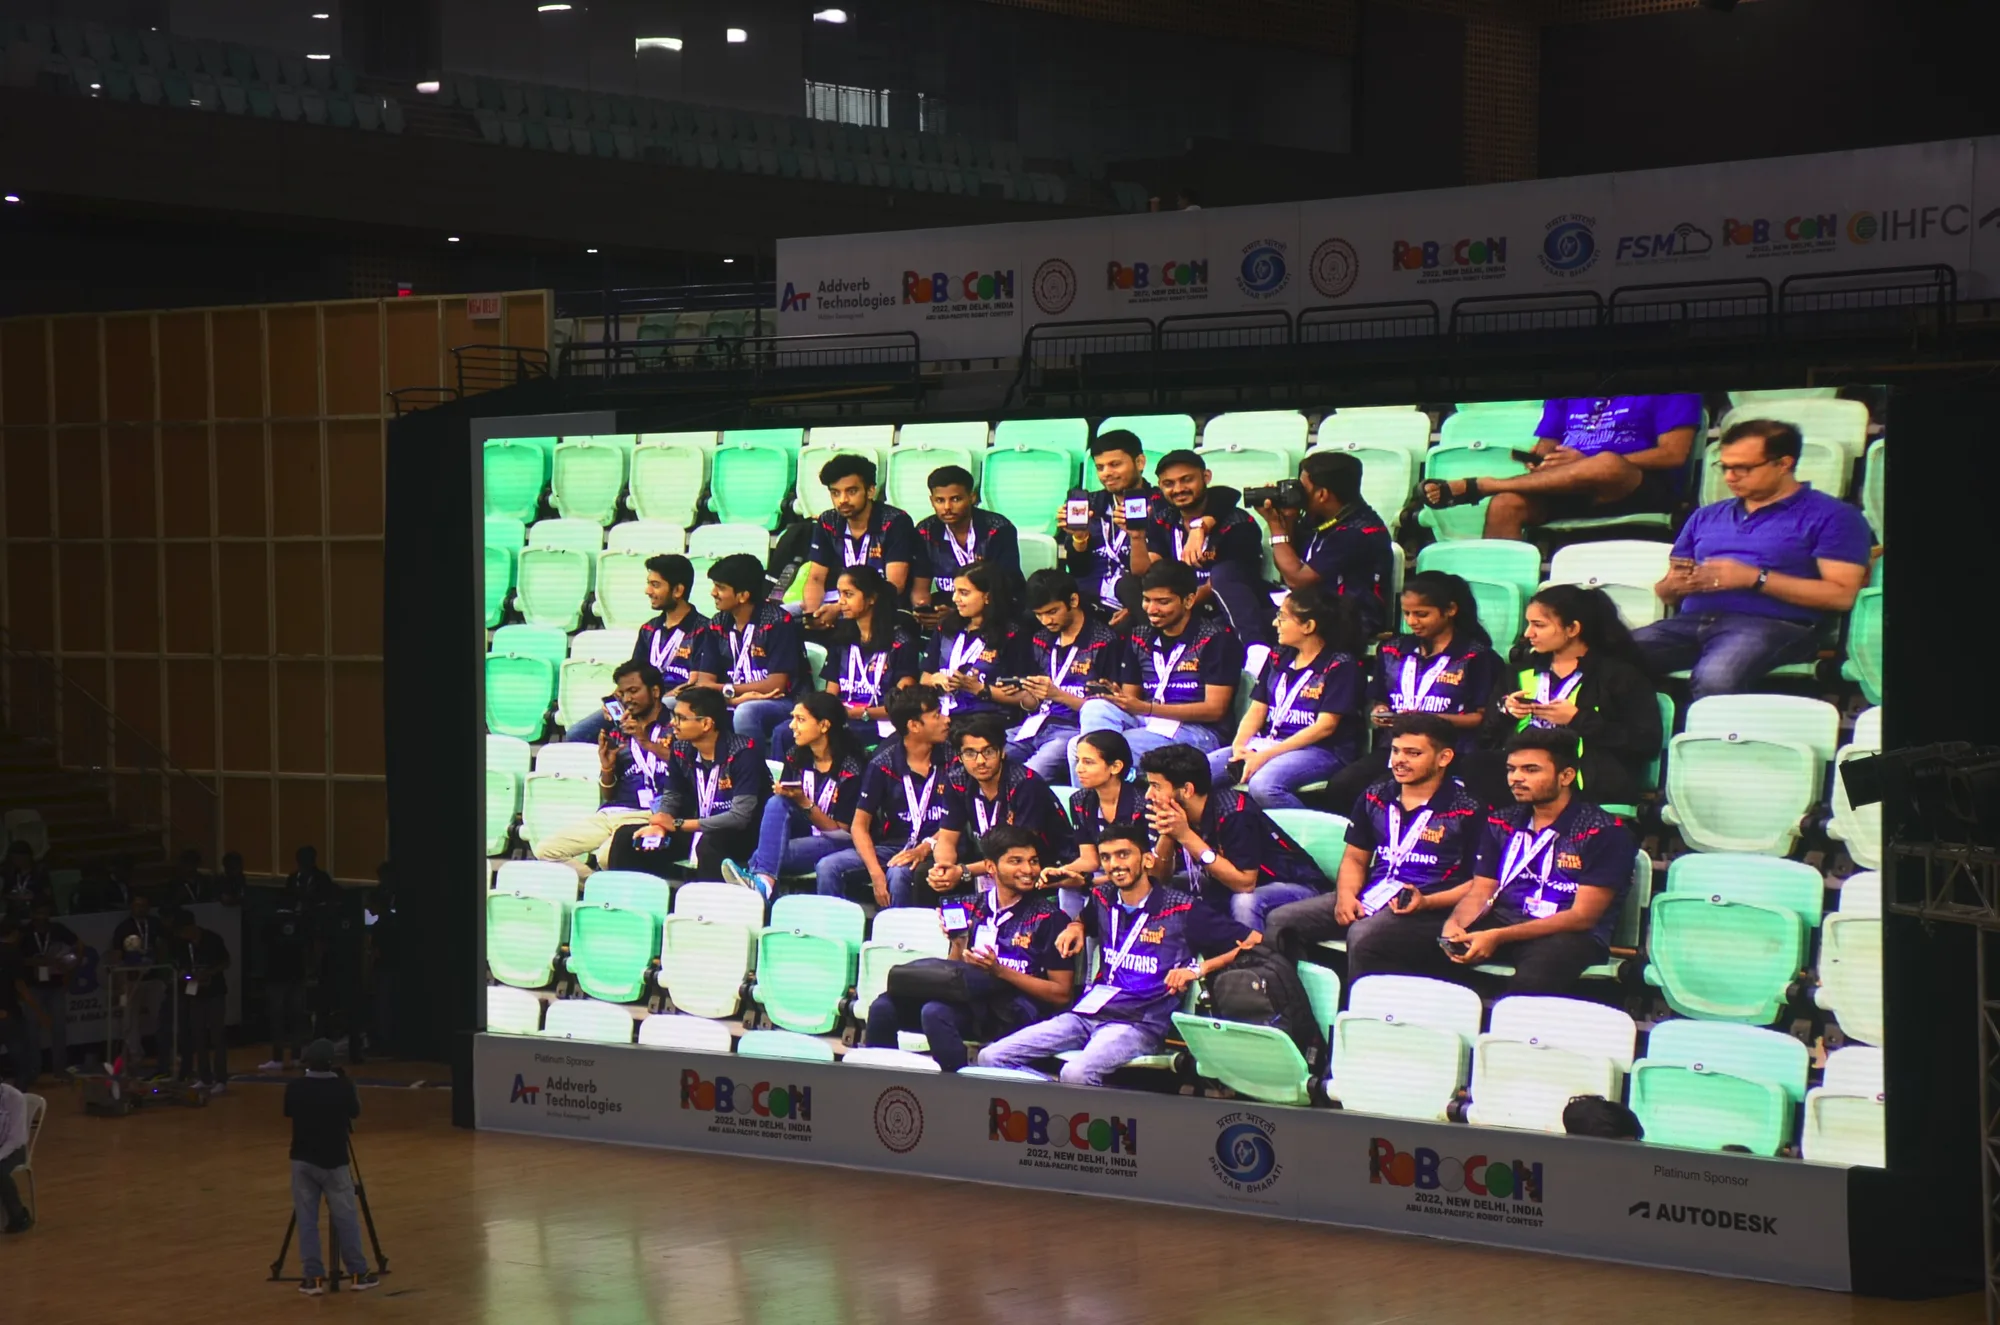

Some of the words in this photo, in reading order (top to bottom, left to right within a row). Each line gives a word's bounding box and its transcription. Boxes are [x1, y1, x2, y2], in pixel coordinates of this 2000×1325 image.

[1881, 203, 1969, 242] IHFC
[1615, 233, 1676, 260] FSM
[817, 277, 870, 293] Addverb
[816, 292, 896, 310] Technologies
[566, 1055, 596, 1067] Sponsor
[546, 1076, 597, 1094] Addverb
[545, 1093, 622, 1115] Technologies
[714, 1115, 736, 1126] 2022,
[739, 1118, 757, 1127] NEW
[759, 1120, 786, 1131] DELHI,
[788, 1123, 812, 1133] INDIA
[1216, 1112, 1242, 1129] प्रसार
[1019, 1158, 1032, 1166] ABU
[1034, 1160, 1078, 1171] ASIA-PACIFIC
[1080, 1165, 1103, 1174] ROBOT
[1105, 1168, 1138, 1178] CONTEST
[1027, 1148, 1051, 1160] 2022,
[1054, 1151, 1075, 1161] NEW
[1077, 1154, 1108, 1167] DELHI,
[1111, 1156, 1137, 1168] INDIA
[1208, 1156, 1241, 1191] PRASAR
[1246, 1163, 1283, 1193] BHARATI
[1653, 1165, 1701, 1181] Platinum
[1703, 1171, 1749, 1187] Sponsor
[1415, 1192, 1443, 1206] 2022,
[1446, 1196, 1471, 1208] NEW
[1473, 1199, 1509, 1214] DELHI,
[1512, 1204, 1543, 1217] INDIA
[1406, 1204, 1422, 1212] ABU
[1424, 1206, 1474, 1219] ASIA-PACIFIC
[1476, 1212, 1503, 1222] ROBOT
[1506, 1216, 1544, 1227] CONTEST
[1656, 1203, 1778, 1235] AUTODESK
